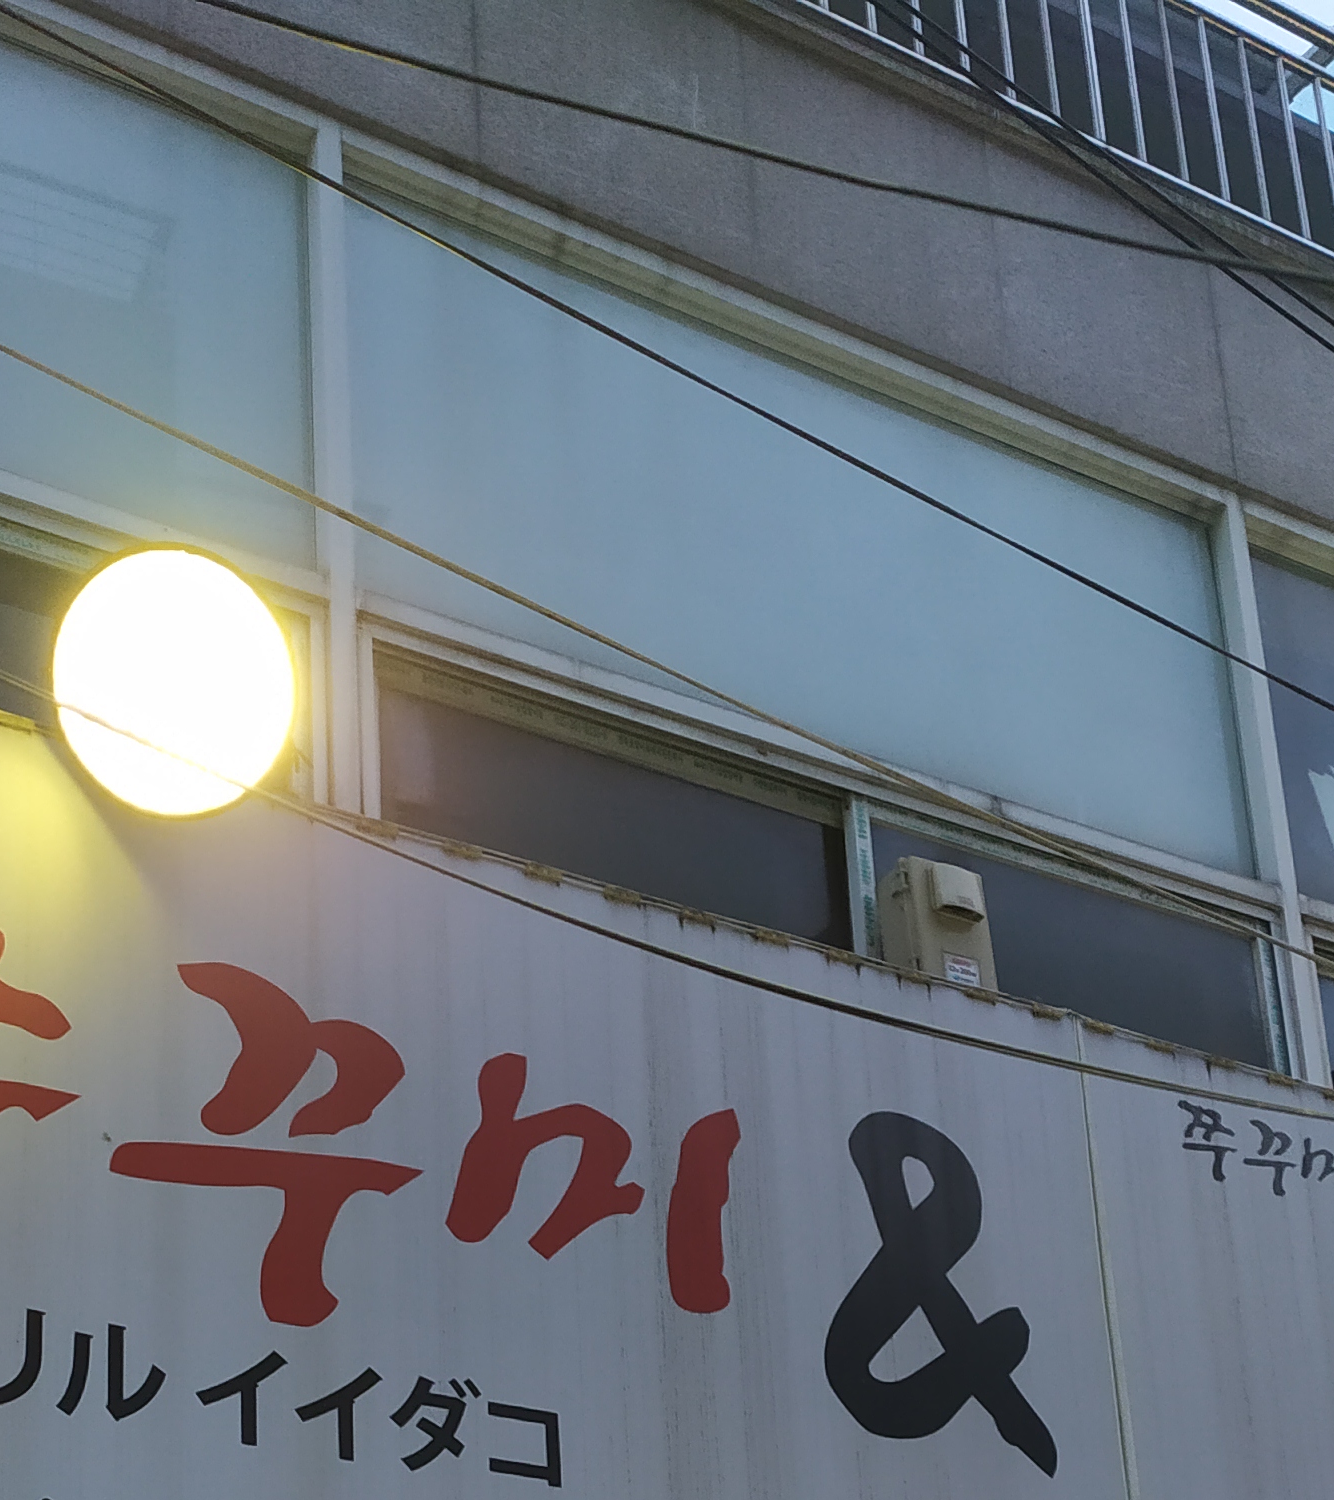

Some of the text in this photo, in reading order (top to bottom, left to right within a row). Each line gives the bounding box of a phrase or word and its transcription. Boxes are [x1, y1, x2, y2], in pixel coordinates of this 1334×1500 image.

[195, 1350, 564, 1489] イイダコ
[825, 1110, 1058, 1479] &
